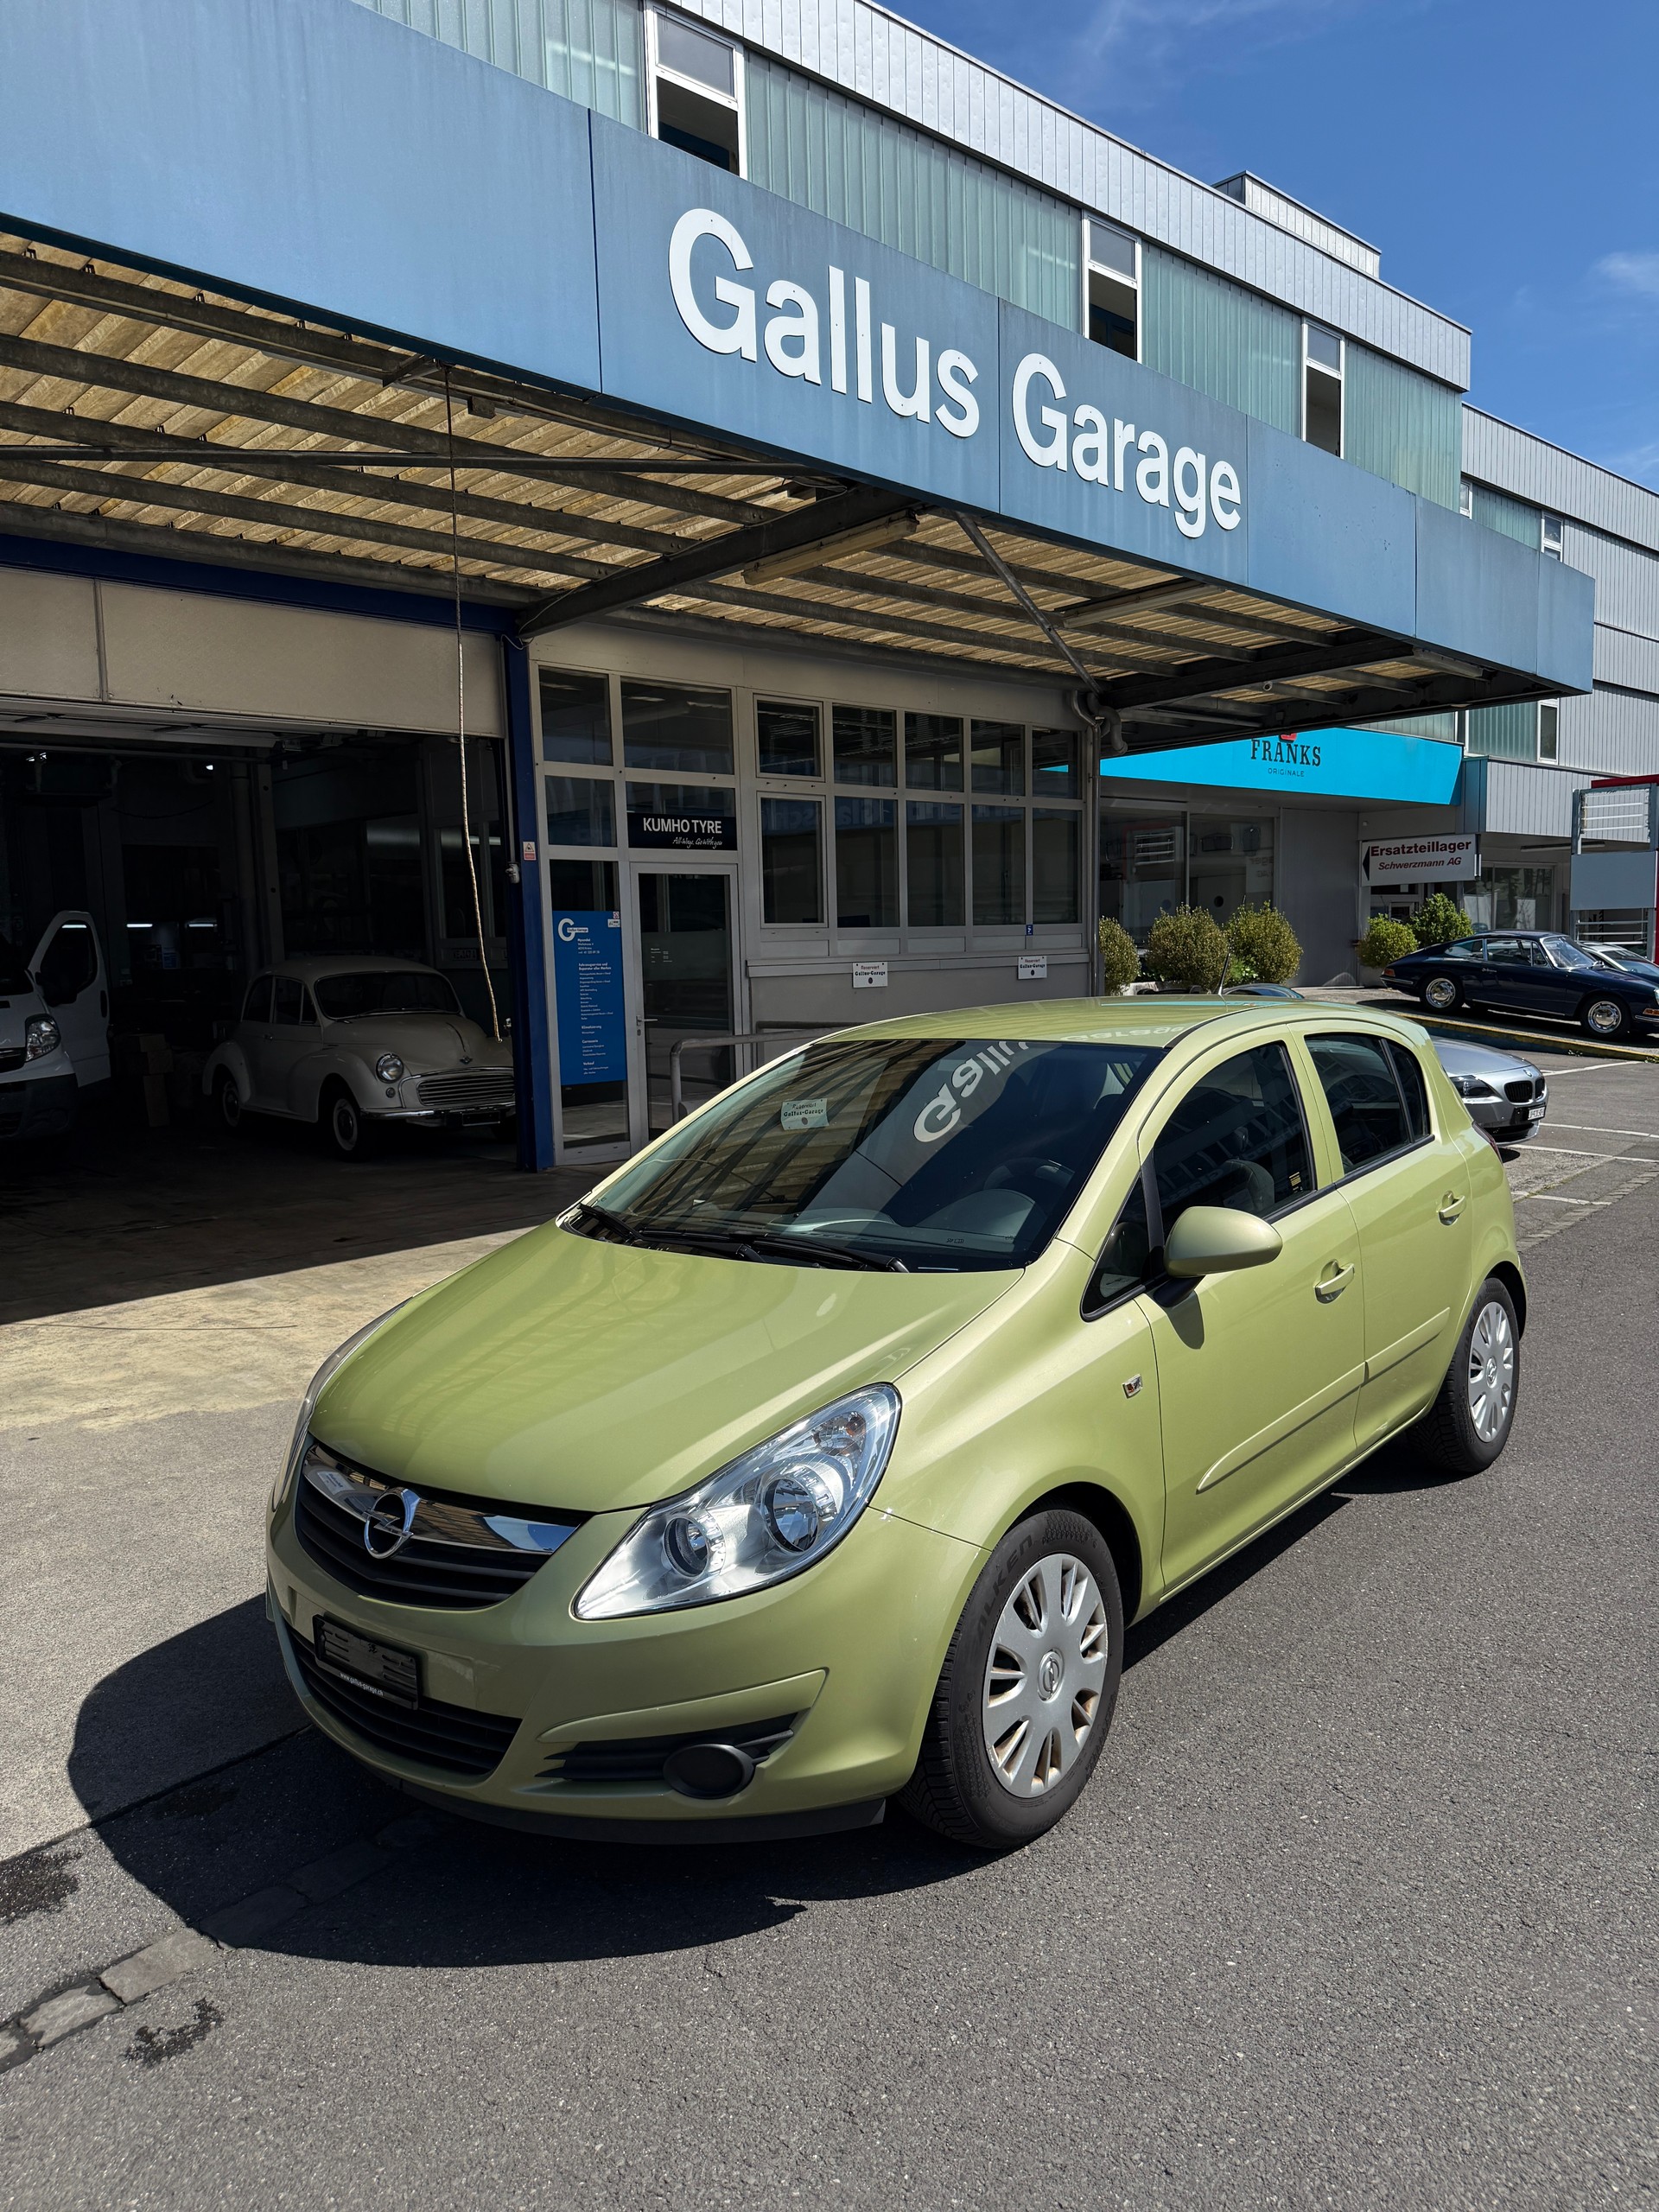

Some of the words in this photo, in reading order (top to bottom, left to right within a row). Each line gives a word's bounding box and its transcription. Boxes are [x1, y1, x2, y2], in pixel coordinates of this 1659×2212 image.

[669, 208, 981, 438] Gallus
[1012, 352, 1241, 538] Garage
[1250, 739, 1321, 766] FRANKS
[1268, 767, 1305, 777] ORIGINALE
[643, 817, 690, 833] KUMHO
[691, 820, 722, 834] TYRE
[1370, 841, 1471, 857] Ersatzteillager
[1378, 859, 1444, 870] Schwerzmann
[1446, 856, 1462, 866] AG
[557, 918, 582, 942] G
[975, 1535, 1033, 1647] ALKEN
[340, 1672, 384, 1696] www.gallus-garage.ch
